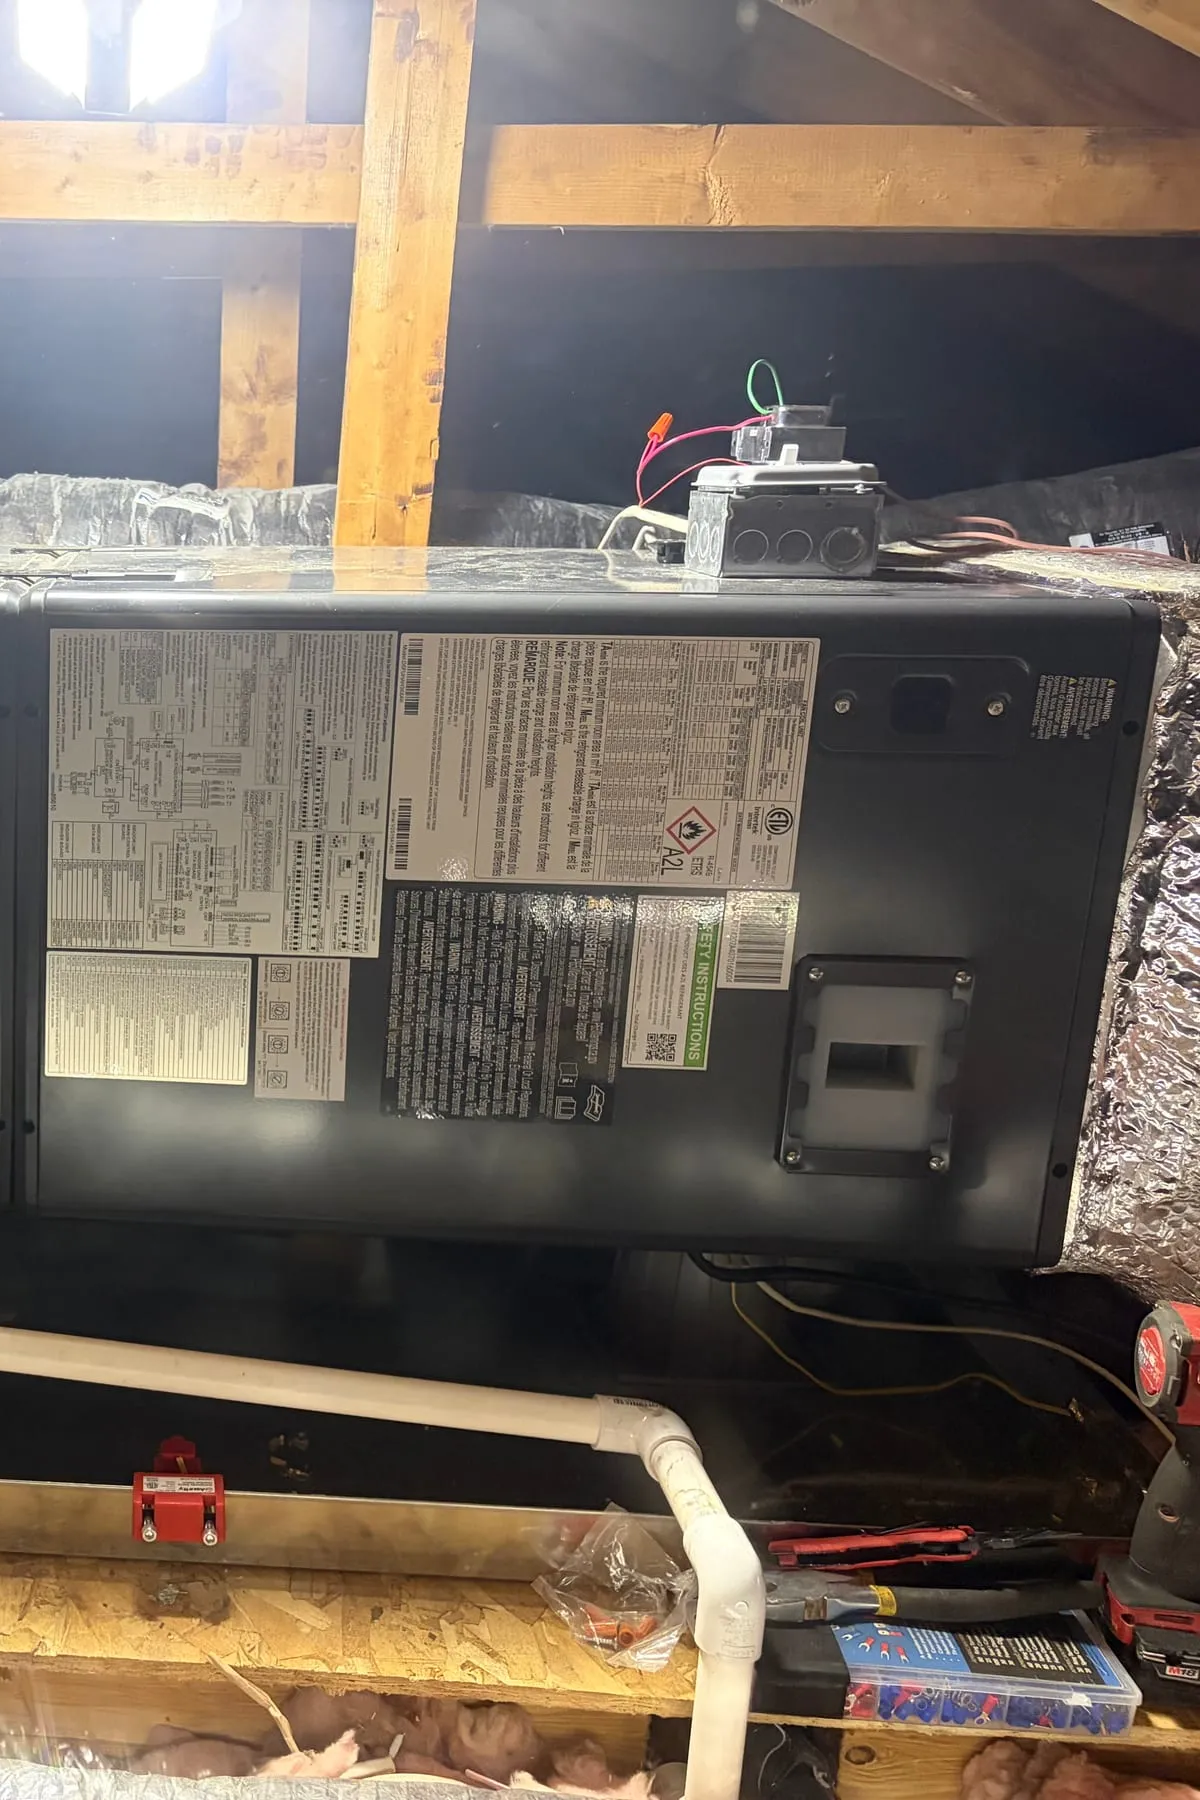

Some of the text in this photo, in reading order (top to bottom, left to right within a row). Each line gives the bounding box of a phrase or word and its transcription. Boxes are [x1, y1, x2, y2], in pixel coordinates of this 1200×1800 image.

[536, 640, 552, 668] refrigerant
[554, 640, 568, 659] Note:
[582, 641, 595, 656] pièce
[522, 640, 538, 685] REMARQUE:
[553, 660, 566, 670] For
[580, 656, 594, 677] requise
[597, 666, 610, 675] the
[520, 686, 534, 699] Pour
[536, 669, 550, 696] releasable
[551, 670, 565, 695] minimum
[593, 676, 609, 698] required
[520, 700, 533, 708] les
[531, 697, 548, 716] charge
[550, 696, 560, 710] room
[593, 699, 607, 724] minimum
[1100, 688, 1115, 721] WARNING:
[518, 709, 532, 732] surfaces
[534, 717, 546, 727] and
[549, 711, 559, 726] areas
[531, 728, 545, 756] installation
[578, 730, 589, 738] the
[592, 725, 601, 739] room
[516, 733, 530, 759] minimales
[544, 734, 559, 751] higher
[572, 739, 588, 766] refrigerant
[591, 739, 600, 752] area
[545, 752, 558, 779] installation
[511, 774, 526, 788] pièce
[573, 767, 586, 794] releasable
[512, 794, 526, 804] des
[541, 802, 551, 812] see
[568, 795, 583, 814] charge
[586, 800, 598, 809] est
[511, 805, 525, 828] hauteurs
[584, 816, 597, 834] surface
[751, 806, 761, 834] Intertek
[538, 813, 553, 842] instructions
[508, 828, 523, 862] d'installations
[538, 842, 550, 850] for
[582, 836, 595, 859] minimale
[505, 863, 519, 874] plus
[536, 851, 549, 872] different
[567, 855, 579, 863] est
[660, 846, 684, 875] A2L
[690, 857, 703, 875] ETRS
[446, 942, 461, 974] WARNING:
[512, 965, 528, 1018] AVERTISSEMENT
[687, 962, 710, 1060] INSTRUCTIONS
[467, 1005, 483, 1057] AVERTISSEMENT
[1168, 1666, 1197, 1677] M18
